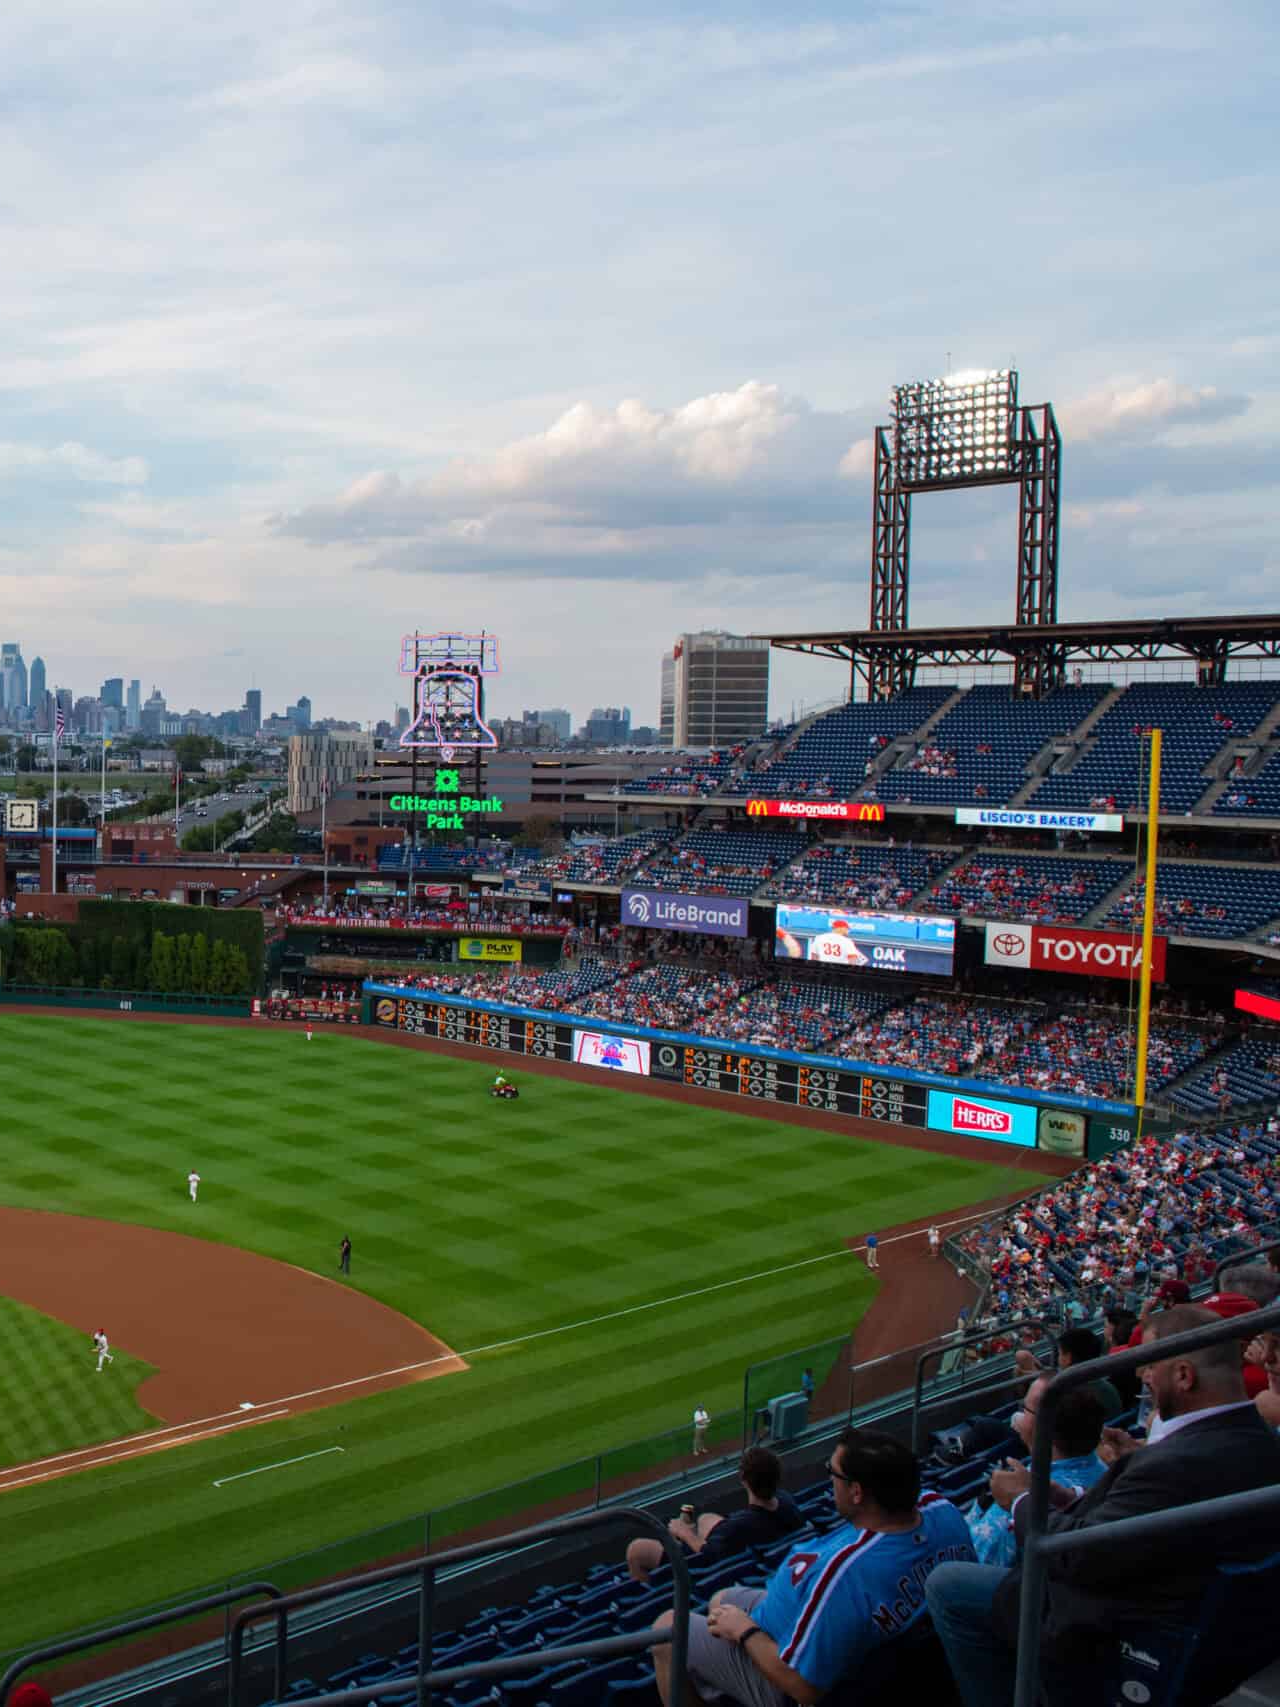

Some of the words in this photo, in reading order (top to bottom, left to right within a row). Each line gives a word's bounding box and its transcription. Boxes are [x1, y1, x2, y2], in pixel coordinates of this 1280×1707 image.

[389, 795, 457, 811] Citizens
[460, 795, 503, 812] Bank
[779, 801, 847, 817] McDonald's
[427, 813, 464, 829] Park
[980, 812, 1036, 825] LISCIO'S
[1040, 814, 1096, 827] BAKERY
[655, 901, 742, 926] LifeBrand
[486, 943, 513, 952] PLAY
[823, 942, 841, 957] 33
[873, 946, 906, 963] OAK
[957, 1106, 1005, 1130] HERR'S
[1110, 1127, 1130, 1142] 330
